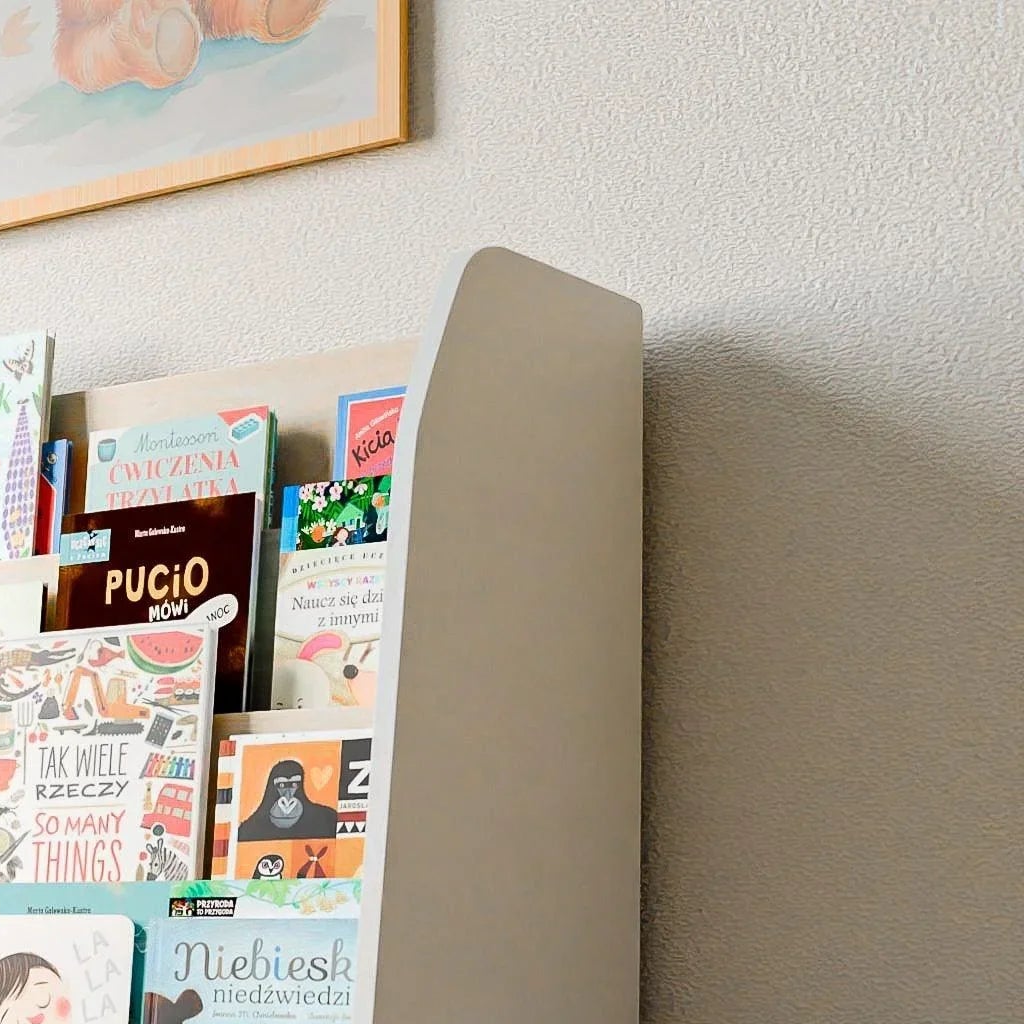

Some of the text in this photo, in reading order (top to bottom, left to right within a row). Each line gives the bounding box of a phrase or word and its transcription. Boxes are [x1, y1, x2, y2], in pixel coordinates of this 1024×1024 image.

[352, 430, 395, 467] Kicia
[109, 449, 240, 484] ĆWICZENIA
[292, 596, 336, 610] Naucz
[339, 592, 358, 608] się
[318, 608, 379, 628] z innymi
[39, 742, 129, 779] TAK WIELE
[35, 780, 129, 800] RZECZY
[32, 809, 126, 837] SO MANY
[32, 839, 122, 882] THINGS
[213, 984, 351, 1007] niedźwiedzi
